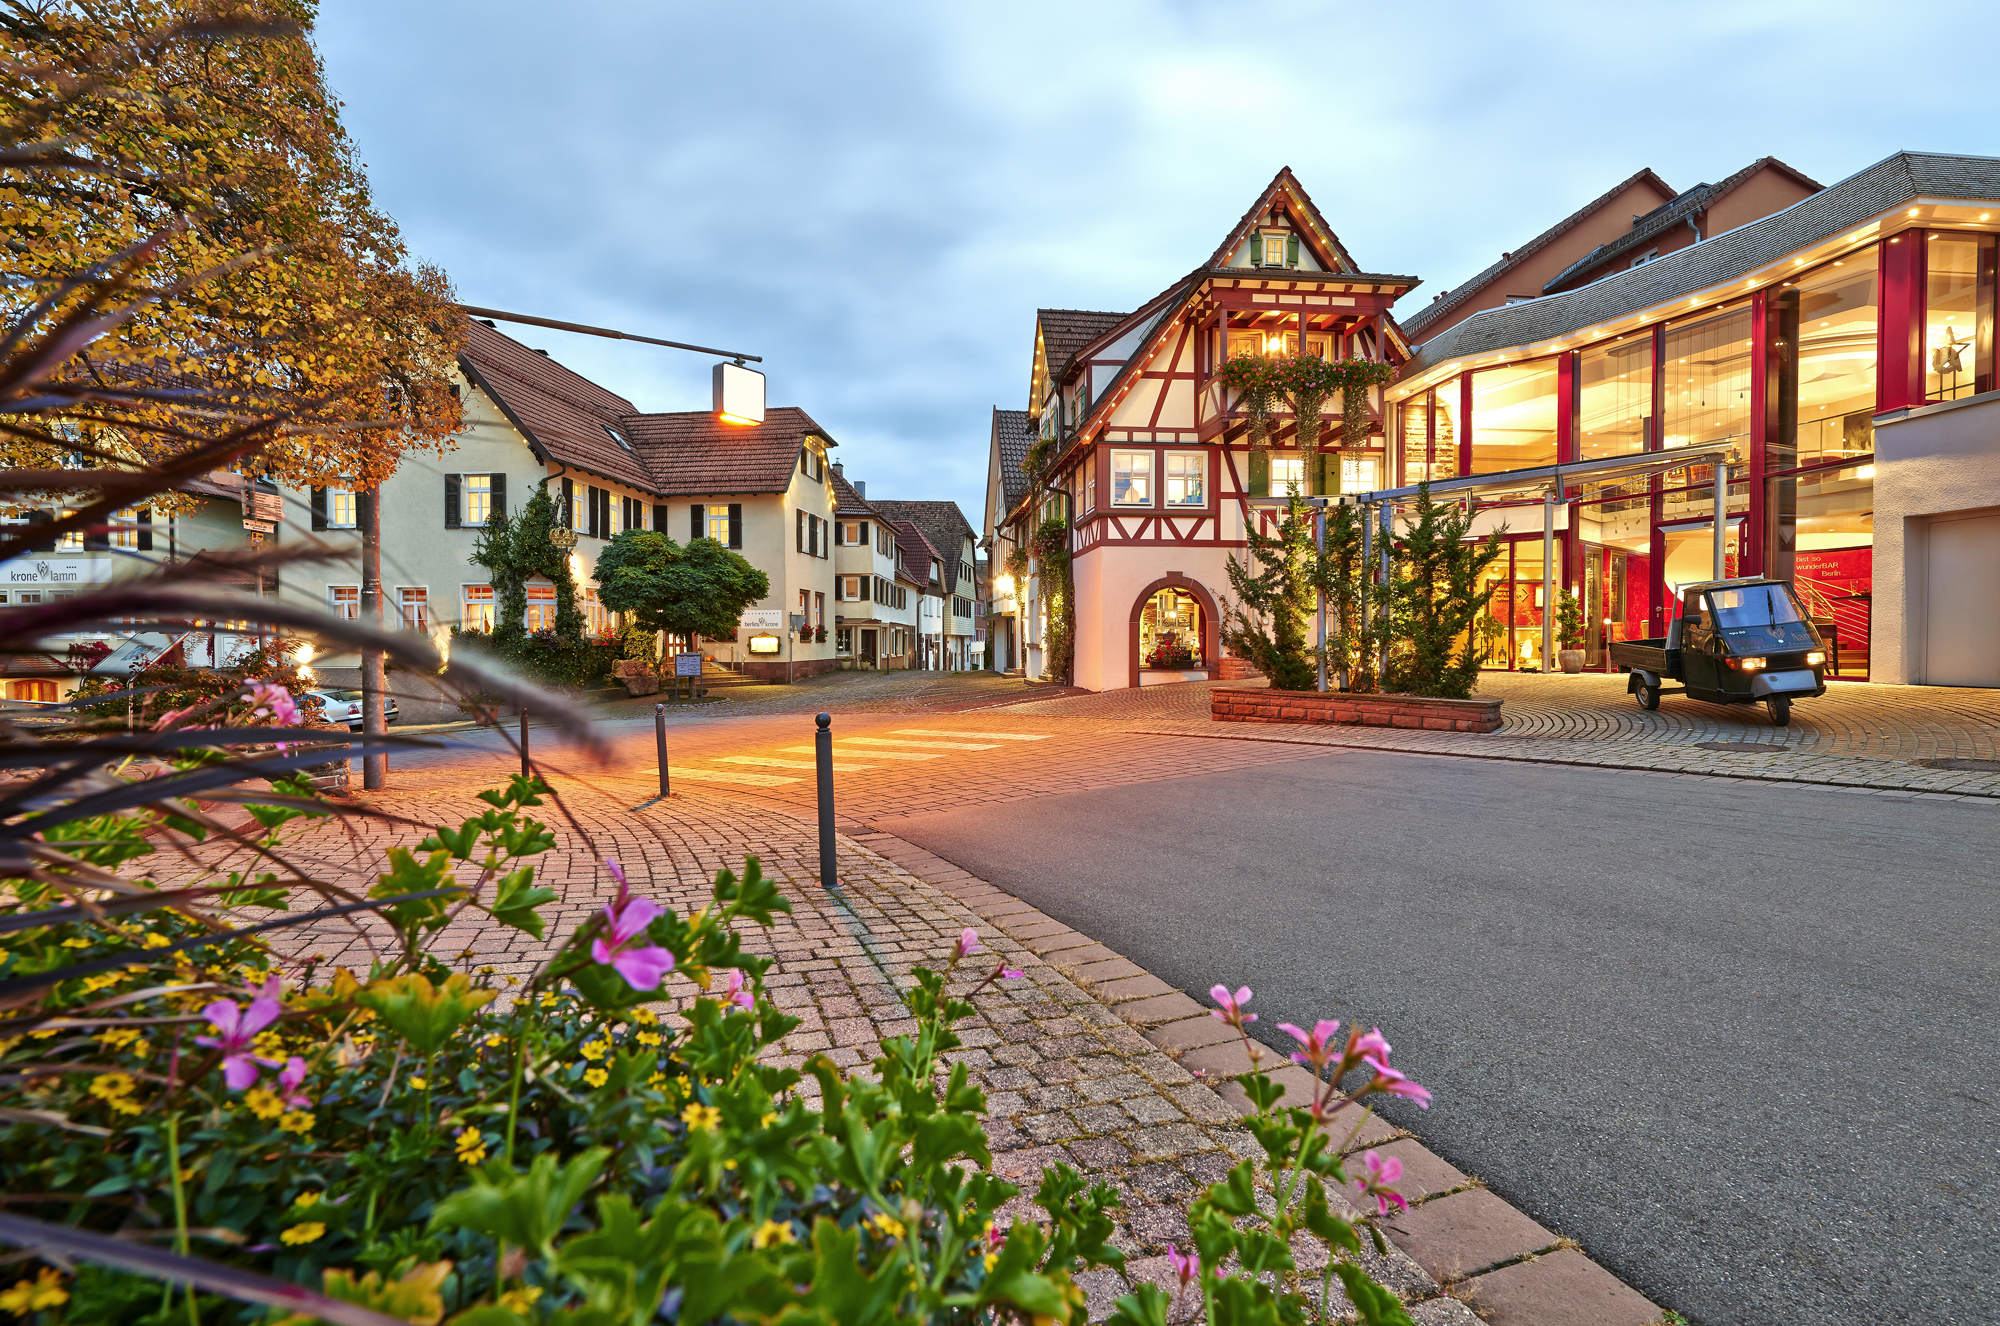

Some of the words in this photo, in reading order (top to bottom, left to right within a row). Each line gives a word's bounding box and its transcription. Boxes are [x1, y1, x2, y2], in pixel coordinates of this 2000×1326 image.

[1796, 562, 1839, 570] wunderBAR
[10, 571, 38, 582] krone
[50, 570, 77, 582] lamm
[1728, 637, 1765, 647] krone
